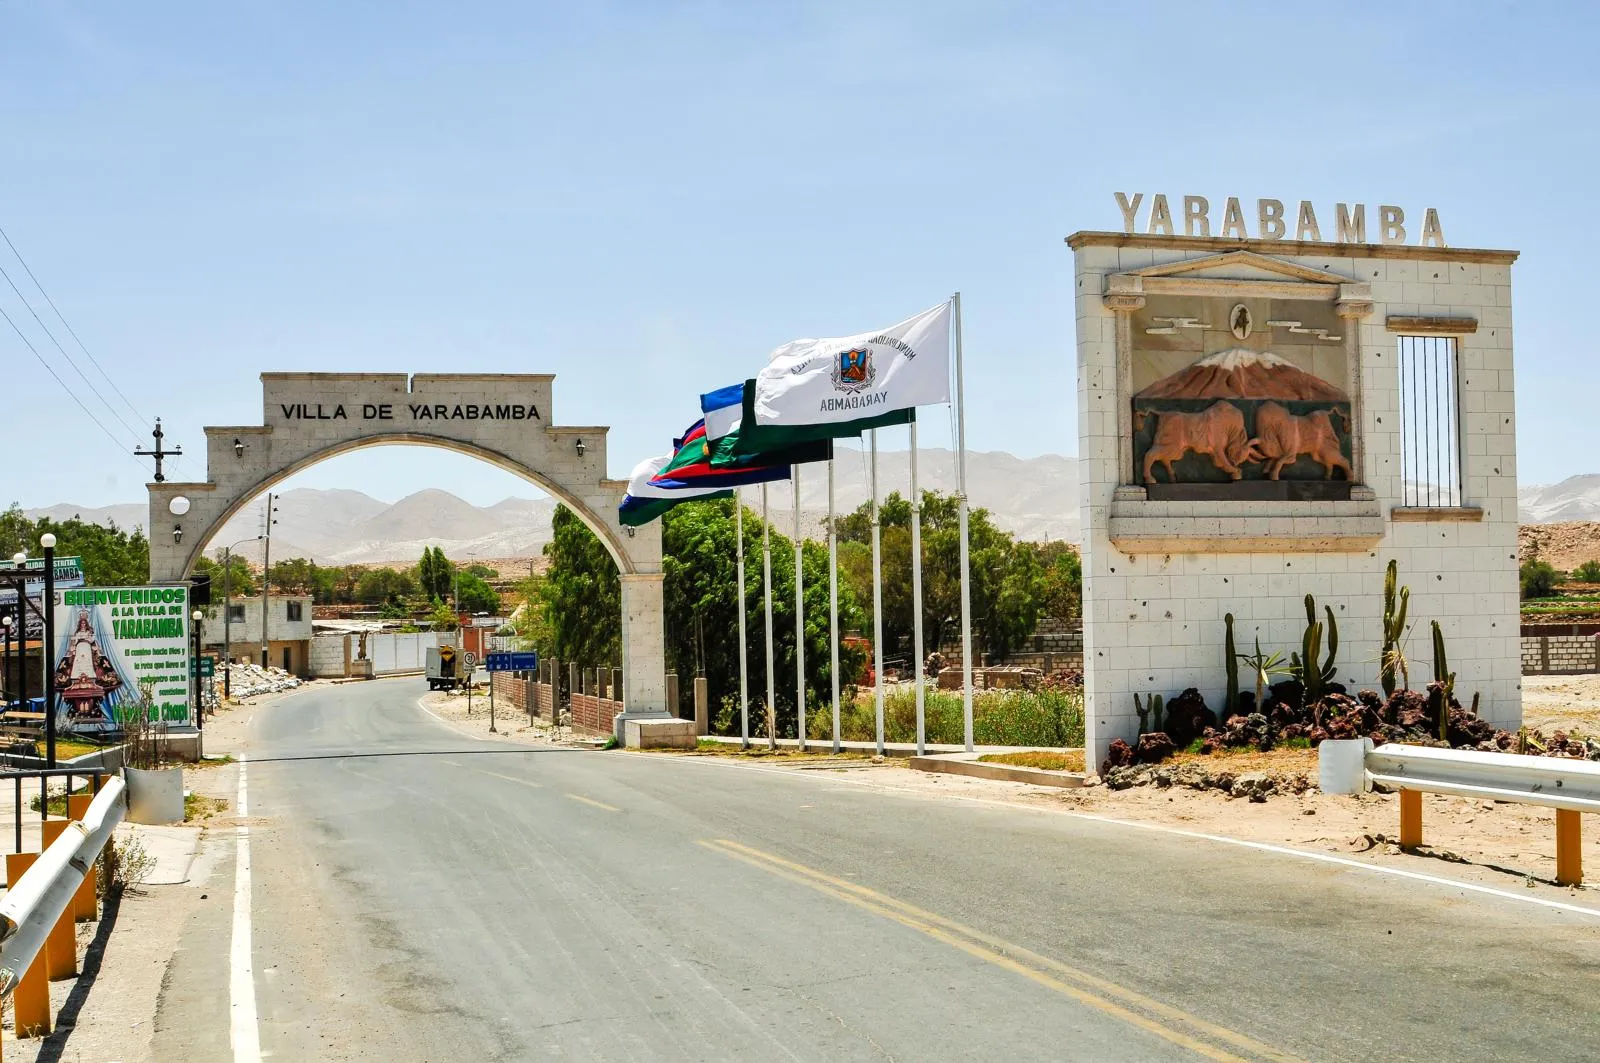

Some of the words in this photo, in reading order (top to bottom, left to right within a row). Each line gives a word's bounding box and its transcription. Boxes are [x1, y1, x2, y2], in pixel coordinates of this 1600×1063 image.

[1113, 191, 1446, 247] YARABAMBA
[281, 404, 348, 420] VILLA
[363, 404, 393, 420] DE
[409, 404, 541, 420] YARABAMBA
[64, 588, 185, 606] BIENVENIDOS
[111, 608, 119, 617] A
[121, 607, 134, 616] LA
[137, 606, 167, 616] VILLA
[168, 605, 182, 615] DE
[112, 618, 184, 640] YARABAMBA
[161, 700, 188, 725] Chapi
